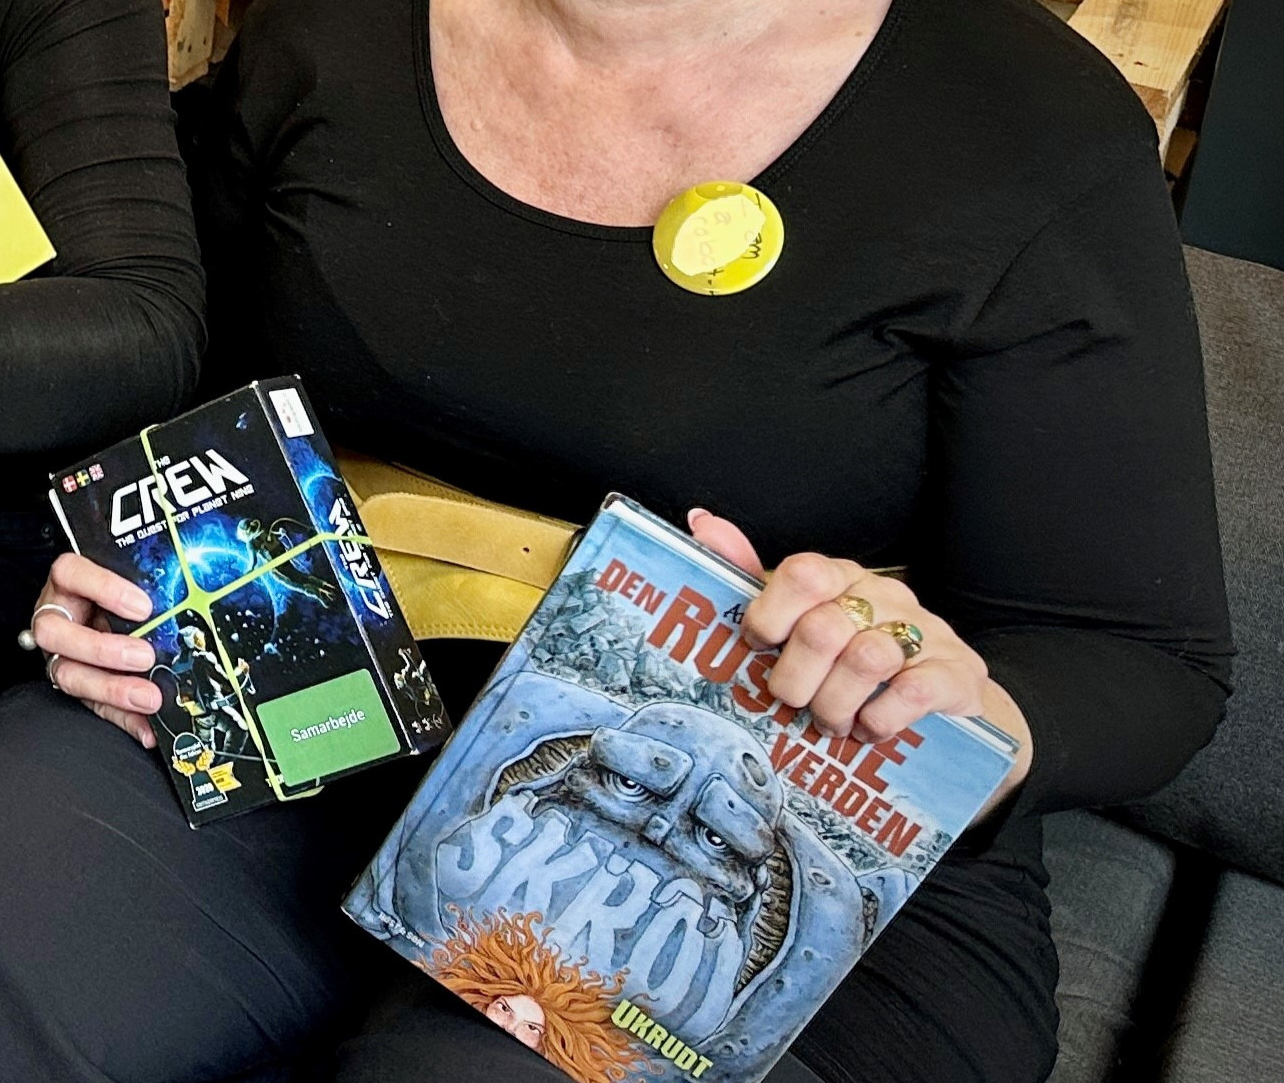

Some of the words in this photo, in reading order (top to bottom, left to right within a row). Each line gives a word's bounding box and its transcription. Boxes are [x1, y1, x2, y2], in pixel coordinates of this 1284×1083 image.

[110, 448, 249, 537] CREW
[115, 535, 135, 549] THE
[137, 520, 168, 539] QUEST
[192, 494, 228, 517] PLANET
[230, 483, 254, 501] NINE
[595, 558, 667, 615] DEN
[291, 707, 366, 744] Samarbejde
[768, 732, 921, 858] VERDEN
[611, 999, 714, 1078] UKRUDT
